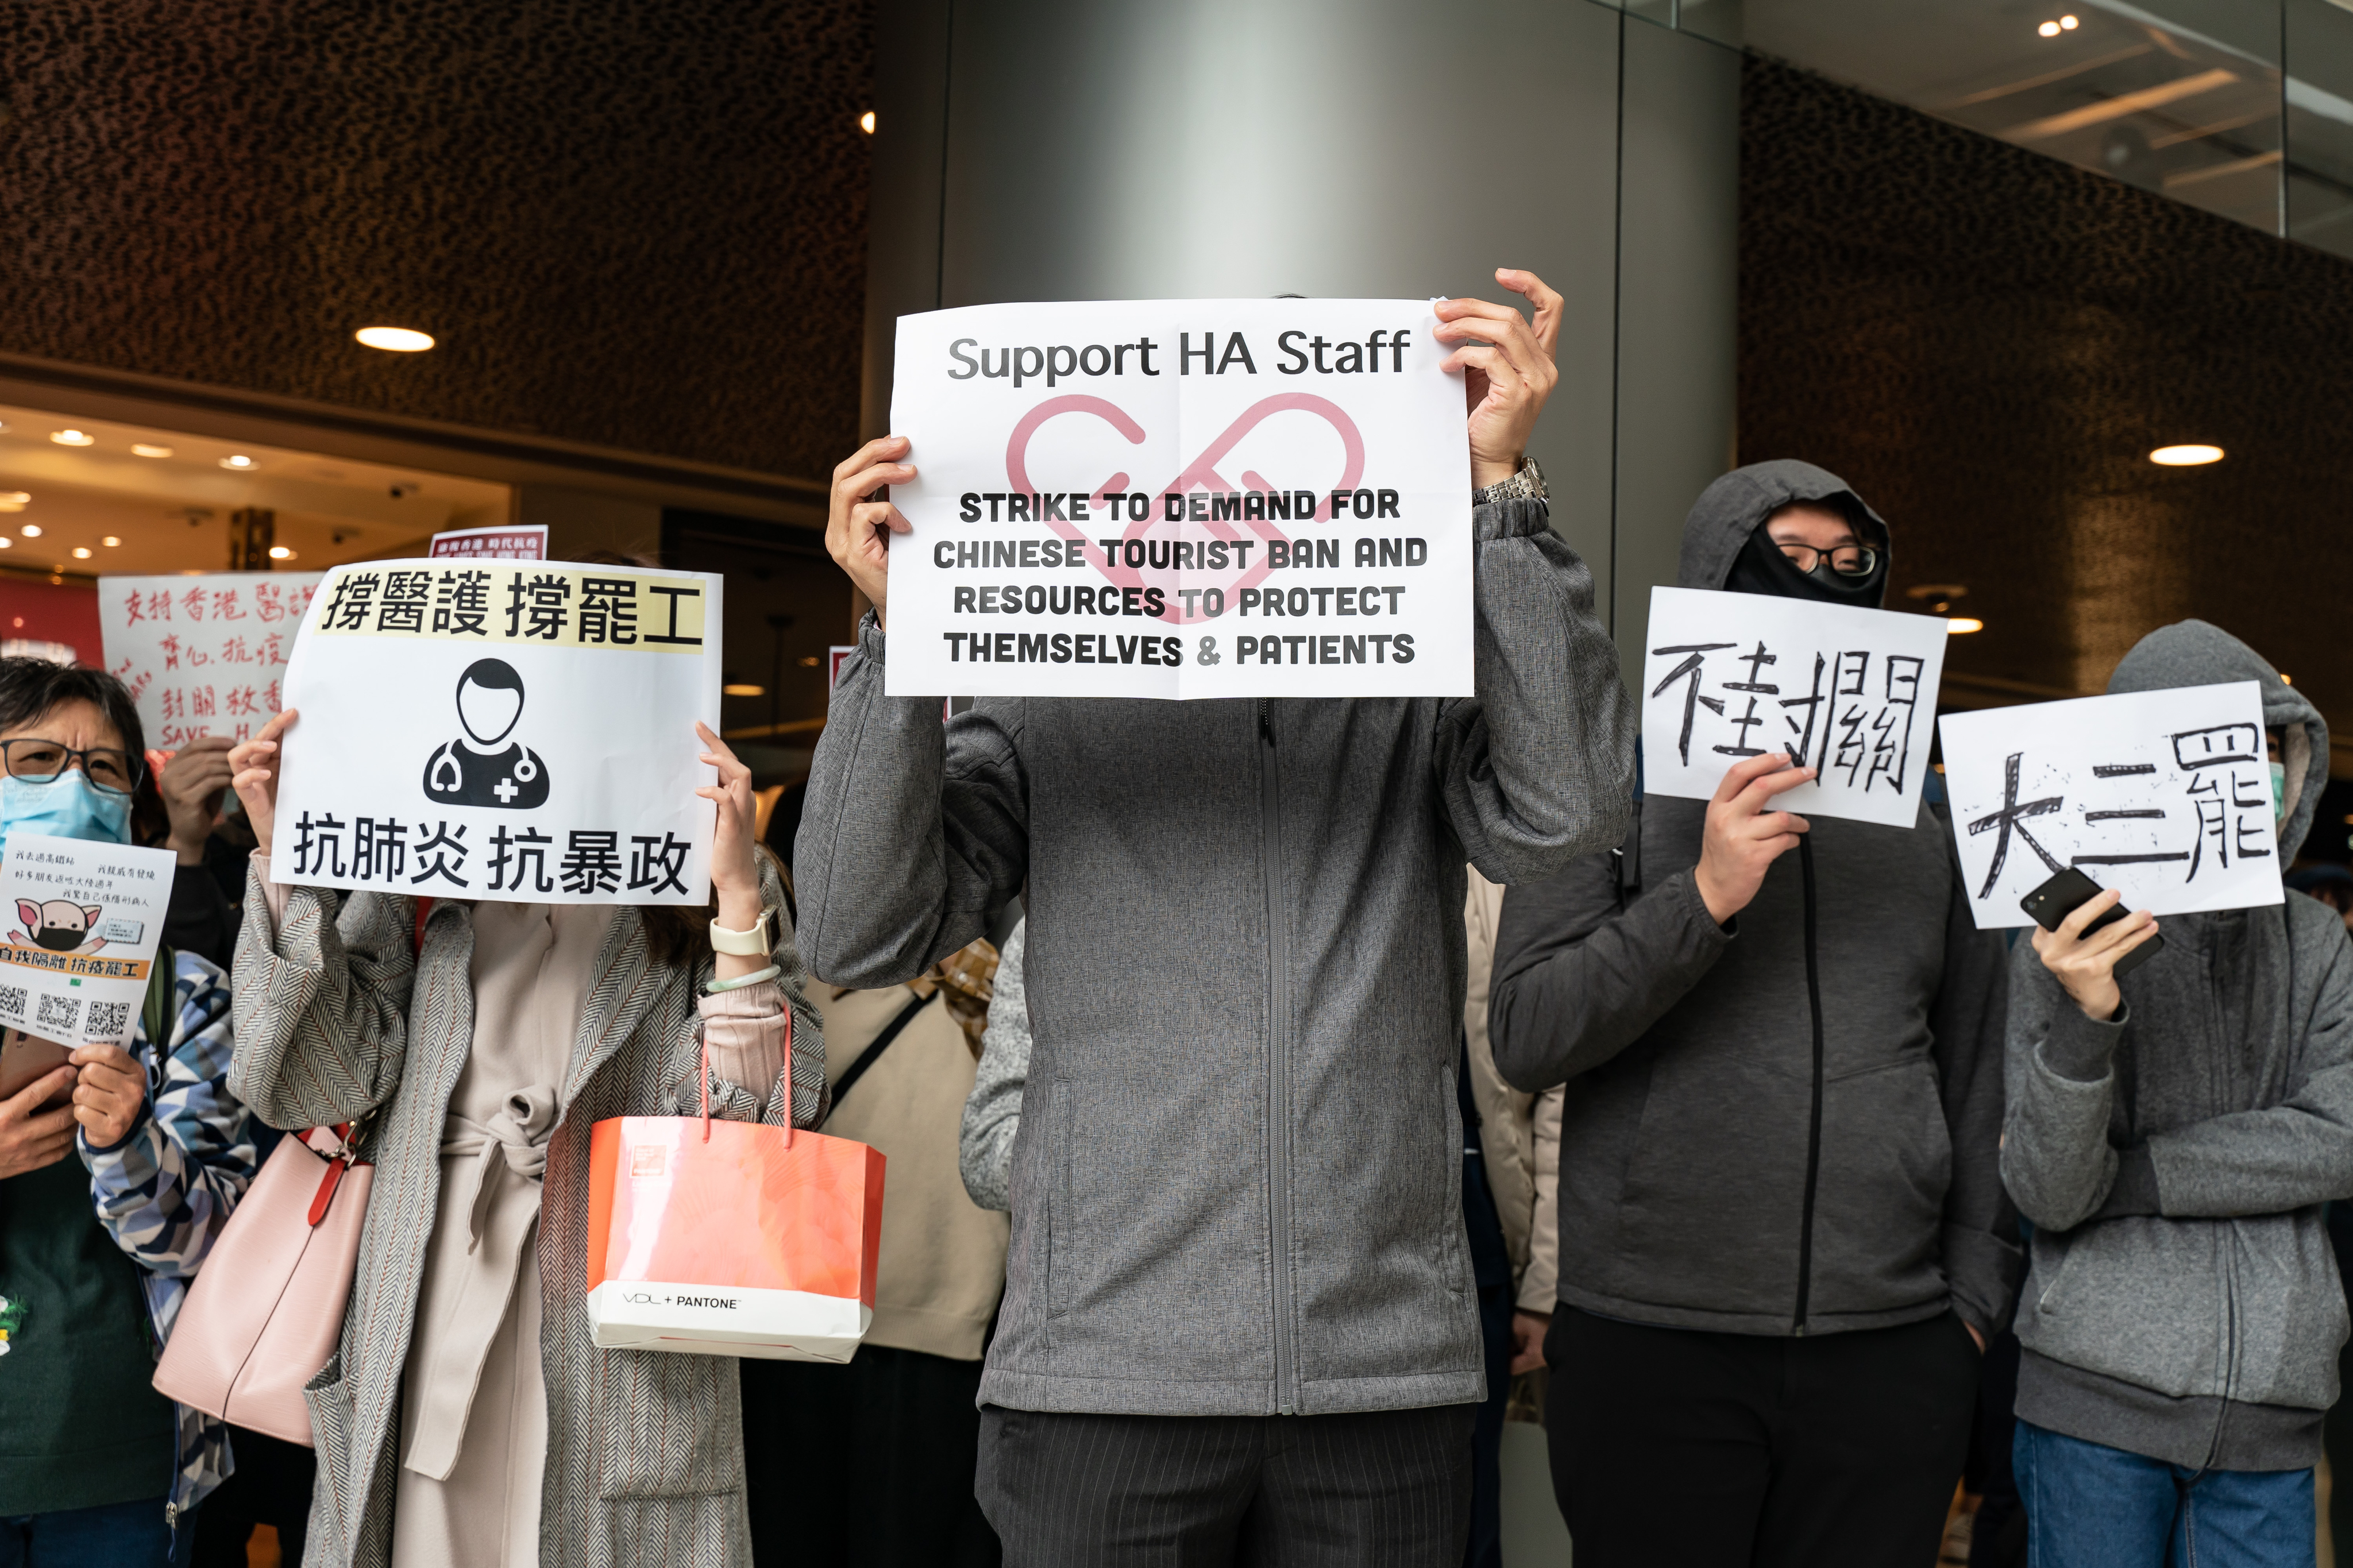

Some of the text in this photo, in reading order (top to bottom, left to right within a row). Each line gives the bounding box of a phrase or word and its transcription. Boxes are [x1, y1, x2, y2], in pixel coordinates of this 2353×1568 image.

[948, 330, 1411, 388] Support HA Staff
[959, 488, 1401, 523] STRIKE TO DEMAND FOR
[933, 537, 1428, 570] CHINESE TOURIST BAN AND
[321, 570, 703, 646] 撐醫護 撐罷工
[954, 585, 1406, 619] RESOURCES TO PROTECT
[943, 632, 1415, 667] THEMSELVES & PATIENTS
[1652, 640, 1924, 795] 不封關
[1968, 723, 2270, 899] 大三罷
[293, 810, 692, 896] 抗肺炎 抗暴政
[0, 947, 67, 971] 自我隔離
[623, 1293, 661, 1304] VDL
